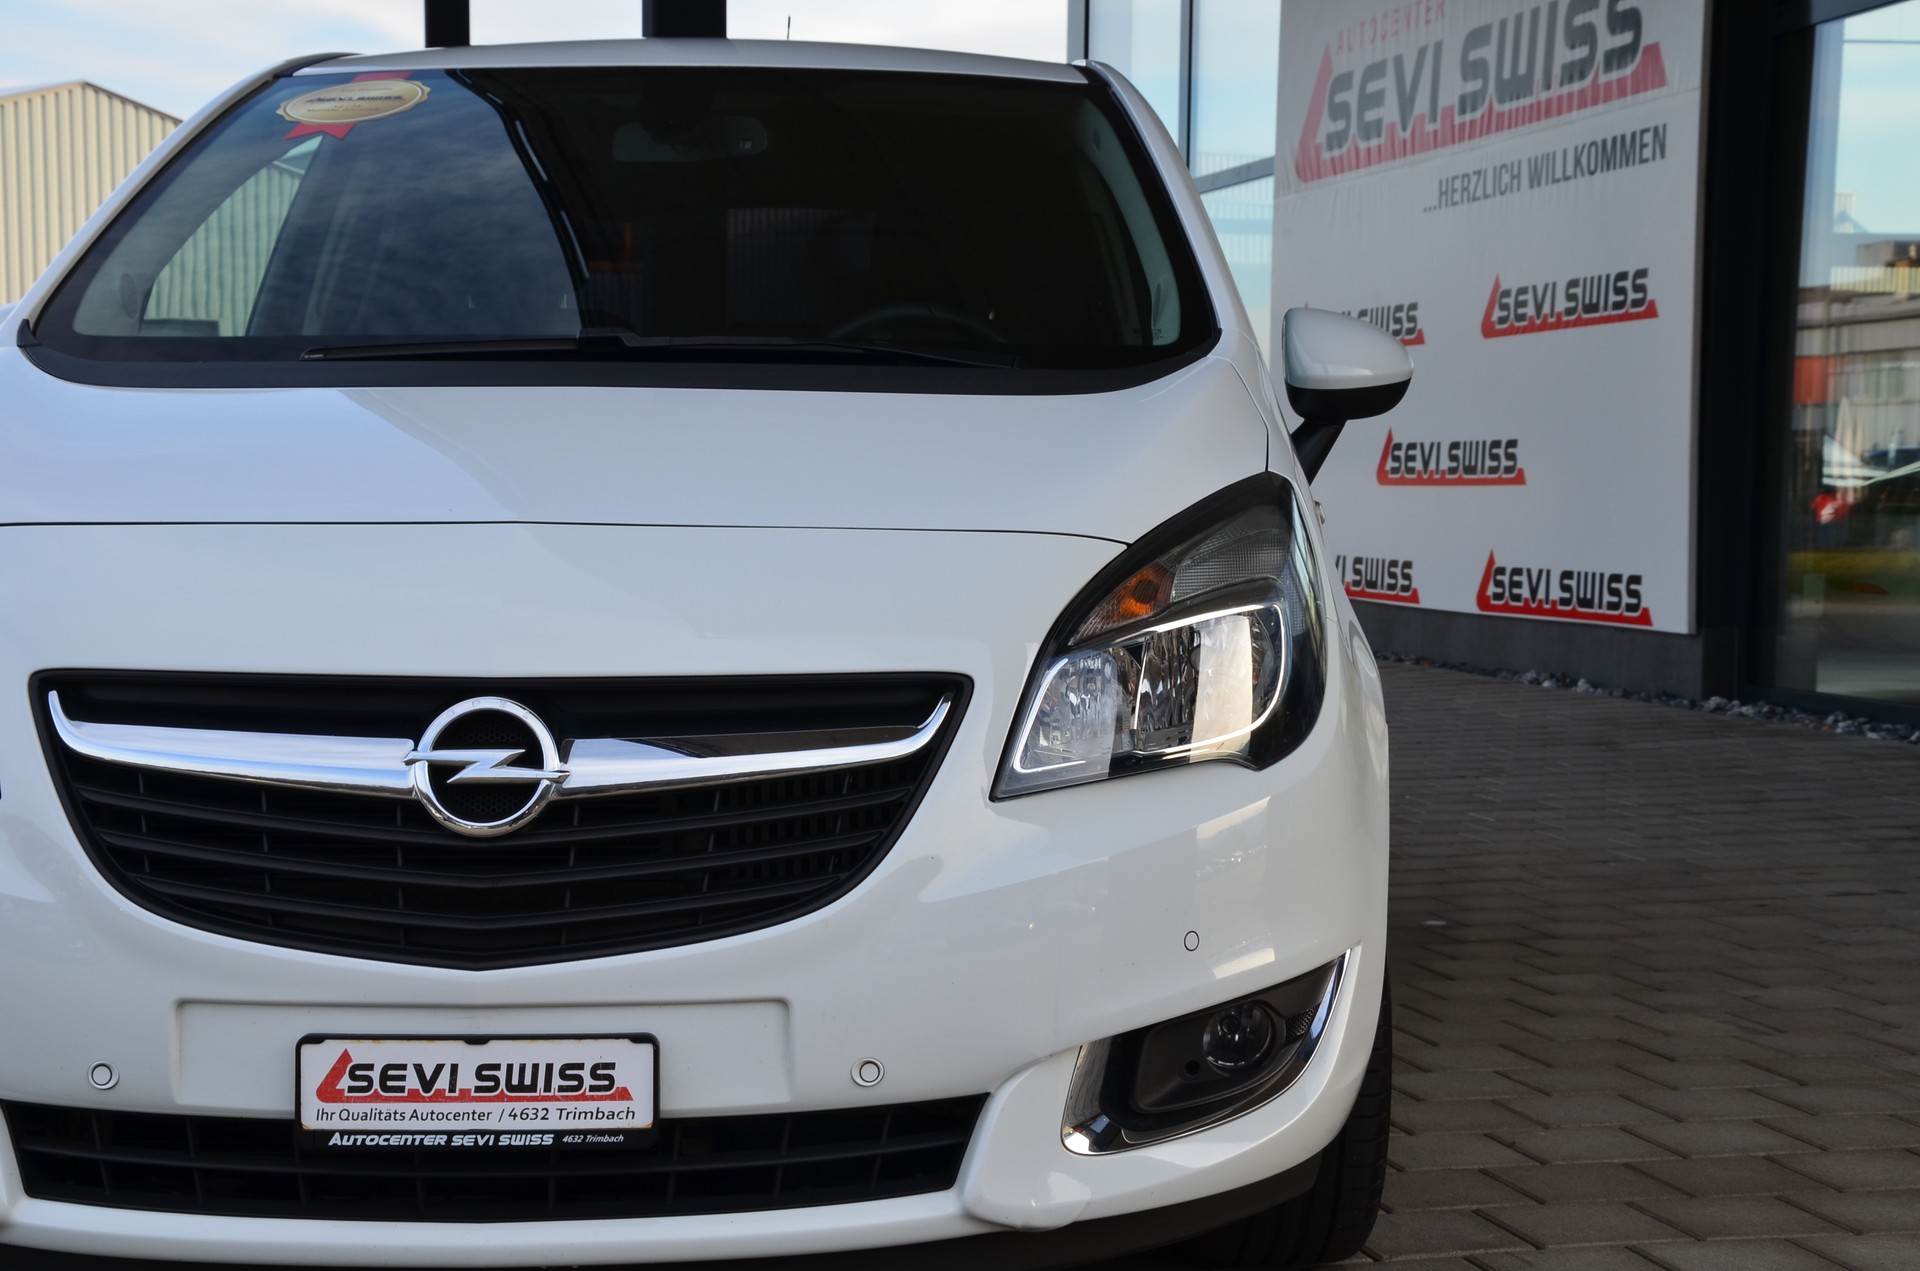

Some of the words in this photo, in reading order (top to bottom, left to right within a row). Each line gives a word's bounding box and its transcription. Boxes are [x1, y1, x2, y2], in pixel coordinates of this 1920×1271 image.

[1336, 0, 1445, 55] AUTOCENTER
[1325, 40, 1444, 153] SEVI
[1457, 0, 1643, 117] SWISS
[1528, 123, 1668, 190] WILLKOMMEN
[1496, 280, 1557, 326] SEVI
[1563, 267, 1649, 317] SWISS
[1389, 441, 1442, 476] SEVI
[1447, 438, 1519, 476] SWISS
[1351, 556, 1414, 594] SWISS
[1491, 566, 1551, 605] SEVI
[1559, 569, 1643, 614] SWISS
[346, 1062, 460, 1095] SEVI
[473, 1061, 617, 1094] SWISS
[316, 1107, 336, 1122] Ihr
[338, 1107, 406, 1122] Qualitäts
[408, 1108, 493, 1122] Autocenter
[556, 1106, 636, 1121] Trimbach
[450, 1133, 496, 1146] SEVI
[498, 1133, 555, 1146] SWISS
[562, 1134, 584, 1143] 4632
[585, 1134, 625, 1143] Trimbach
